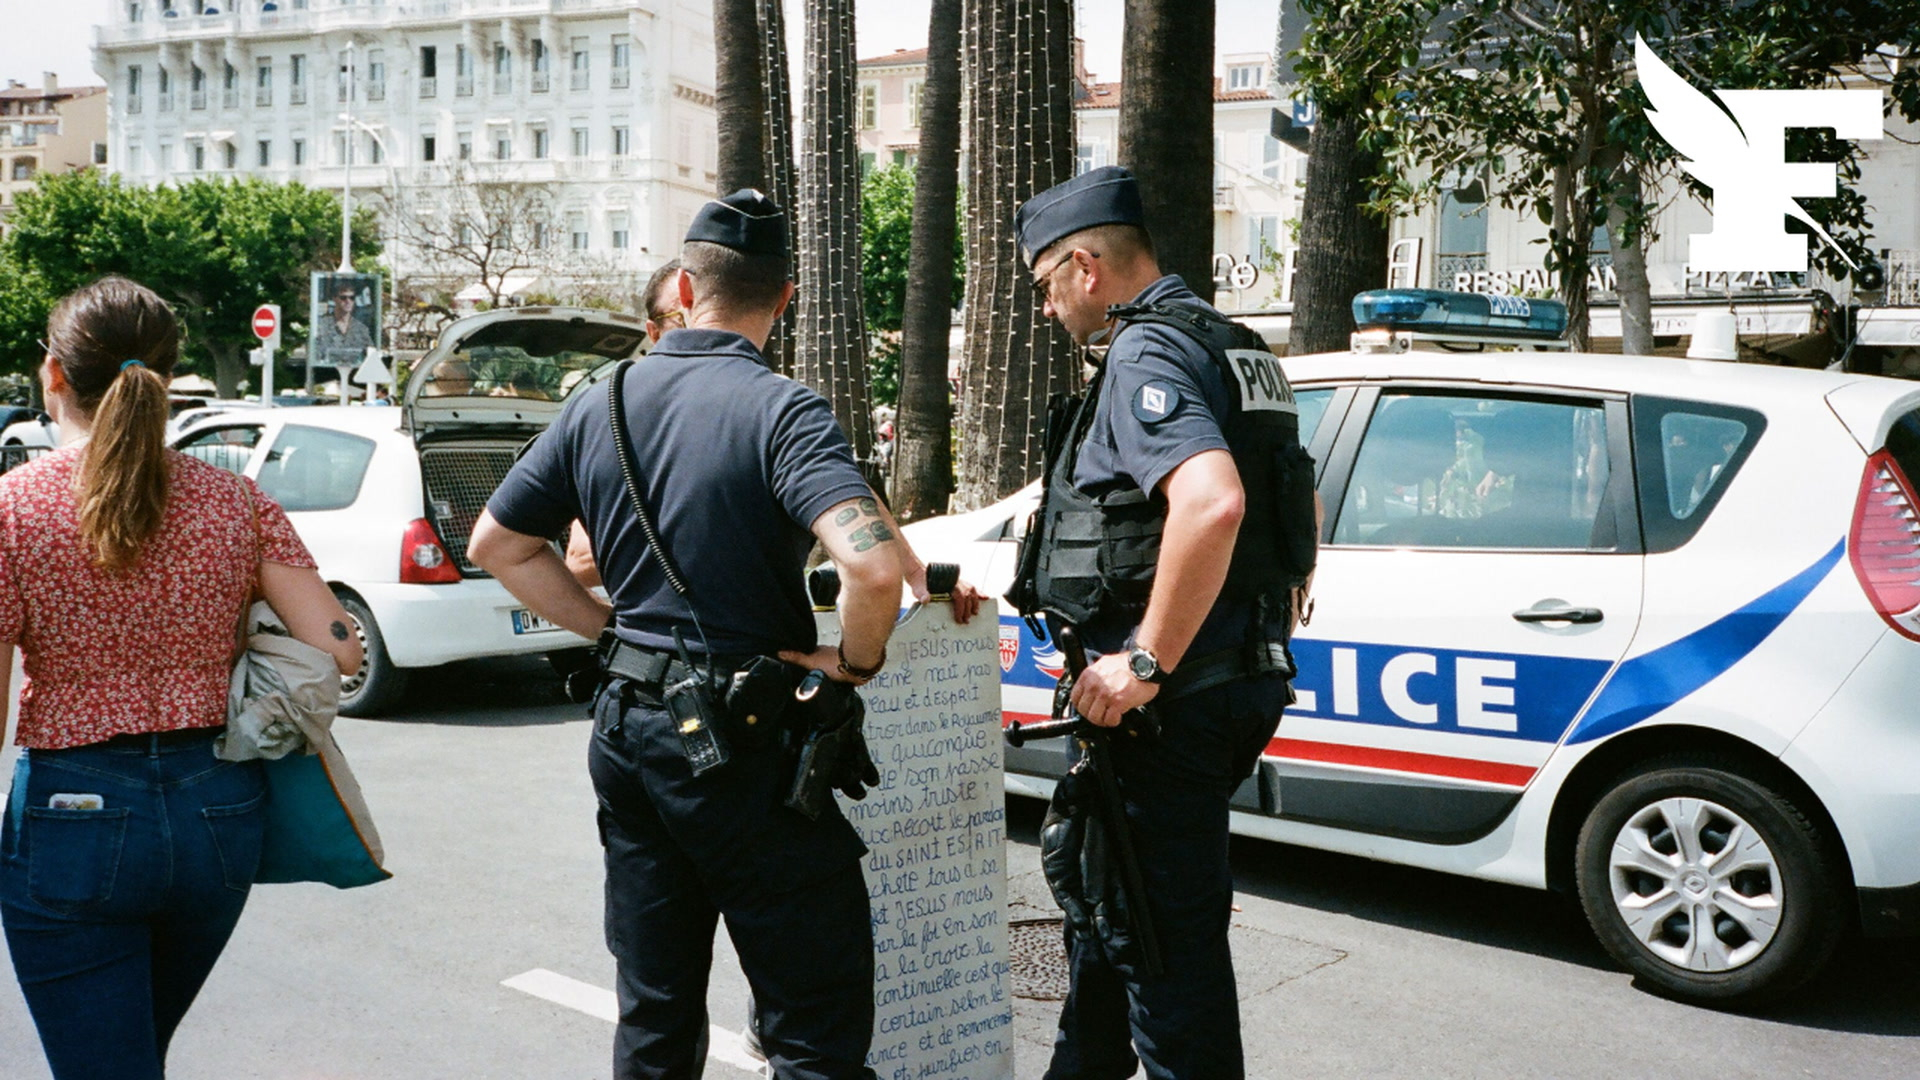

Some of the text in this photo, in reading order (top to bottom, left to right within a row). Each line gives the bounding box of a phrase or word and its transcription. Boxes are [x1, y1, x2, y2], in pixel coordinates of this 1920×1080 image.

[1454, 265, 1618, 298] RESTAUAN
[1491, 296, 1529, 316] POLICE
[901, 635, 996, 671] JESUS nous
[1286, 647, 1518, 732] ICE
[895, 892, 947, 930] JESUS
